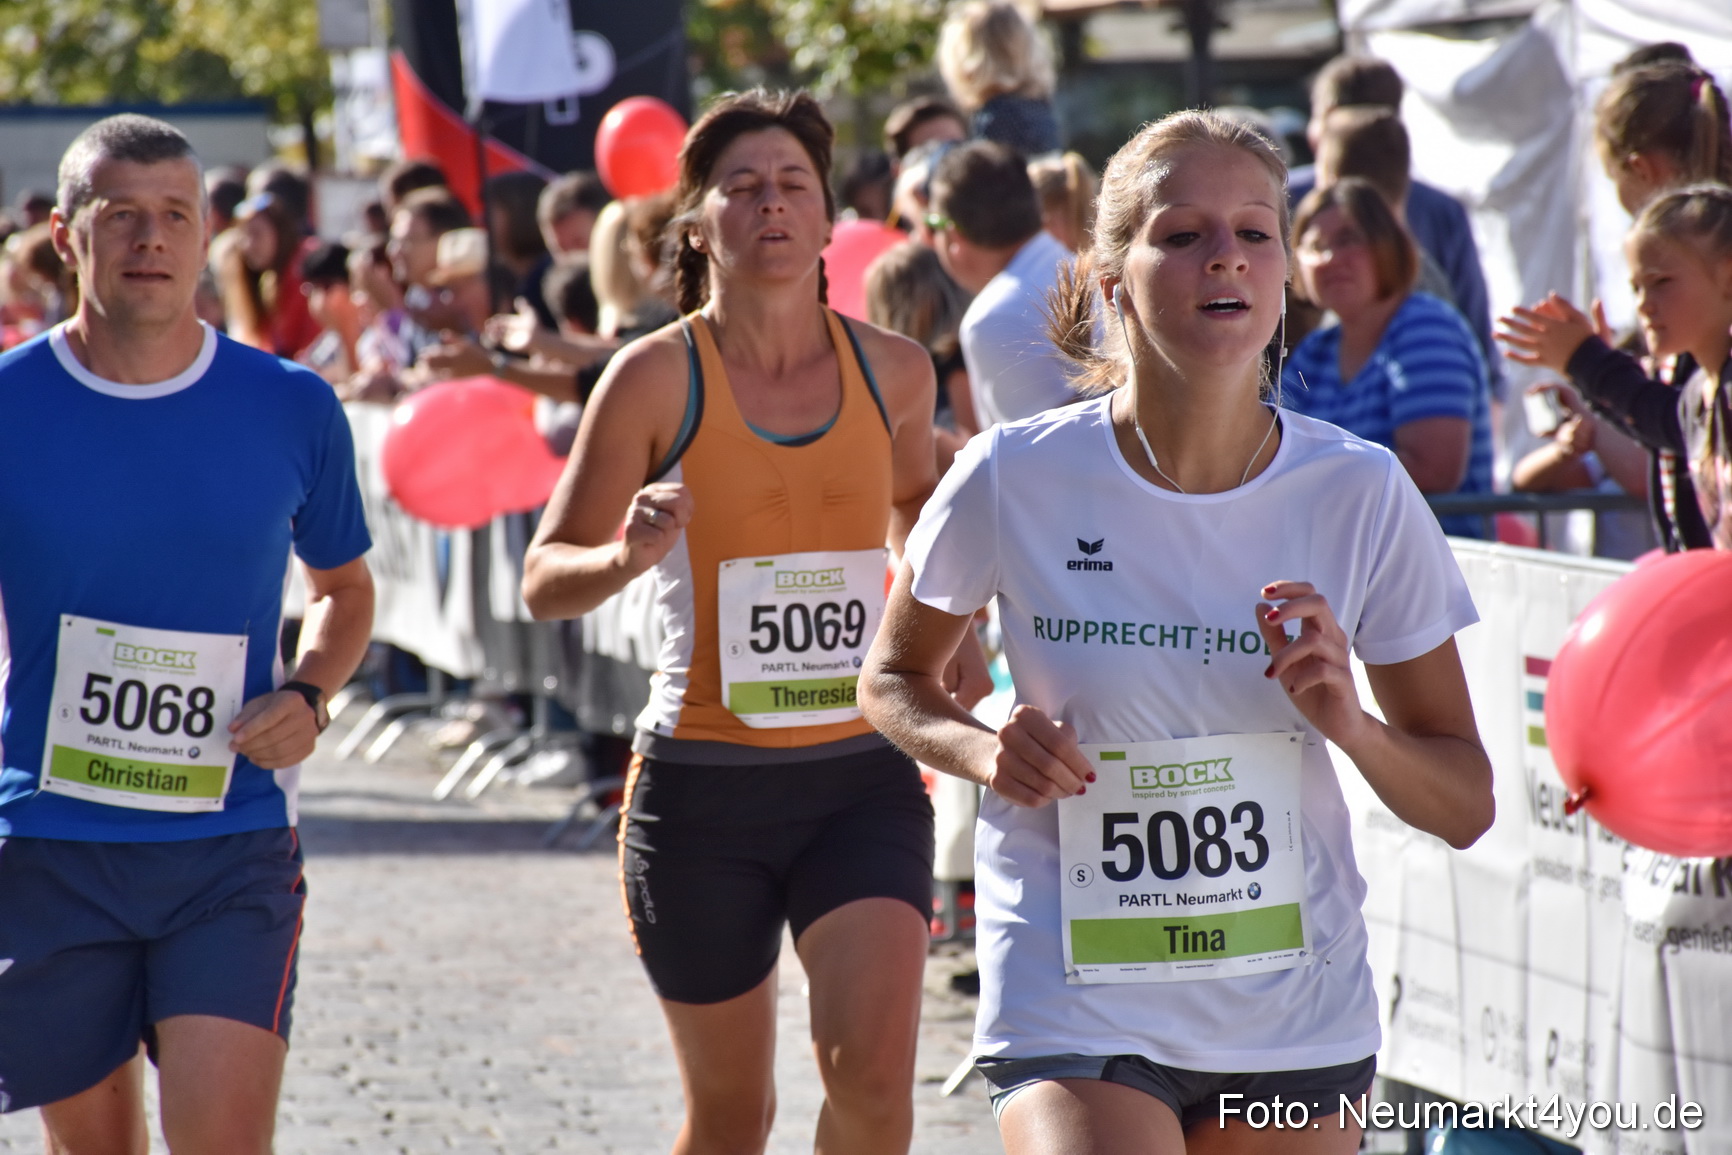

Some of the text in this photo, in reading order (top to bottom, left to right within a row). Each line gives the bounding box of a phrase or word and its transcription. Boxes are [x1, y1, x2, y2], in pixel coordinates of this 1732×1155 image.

[1067, 558, 1113, 571] erima
[775, 568, 845, 588] BOCK
[749, 599, 866, 654] 5069
[1033, 615, 1295, 656] RUPPRECHT HO
[113, 642, 197, 669] BOCK
[761, 660, 850, 673] PARTL Neumarkt
[80, 672, 215, 739] 5068
[770, 682, 858, 708] Theresia
[87, 734, 184, 757] PARTL Neumarkt
[87, 759, 189, 792] Christian
[1130, 757, 1235, 789] BOCK
[1132, 783, 1236, 800] inspired by smart concepts
[1101, 800, 1270, 883] 5083
[1076, 869, 1086, 882] S
[1119, 888, 1243, 907] PARTL Neumarkt
[1163, 925, 1226, 954] Tina
